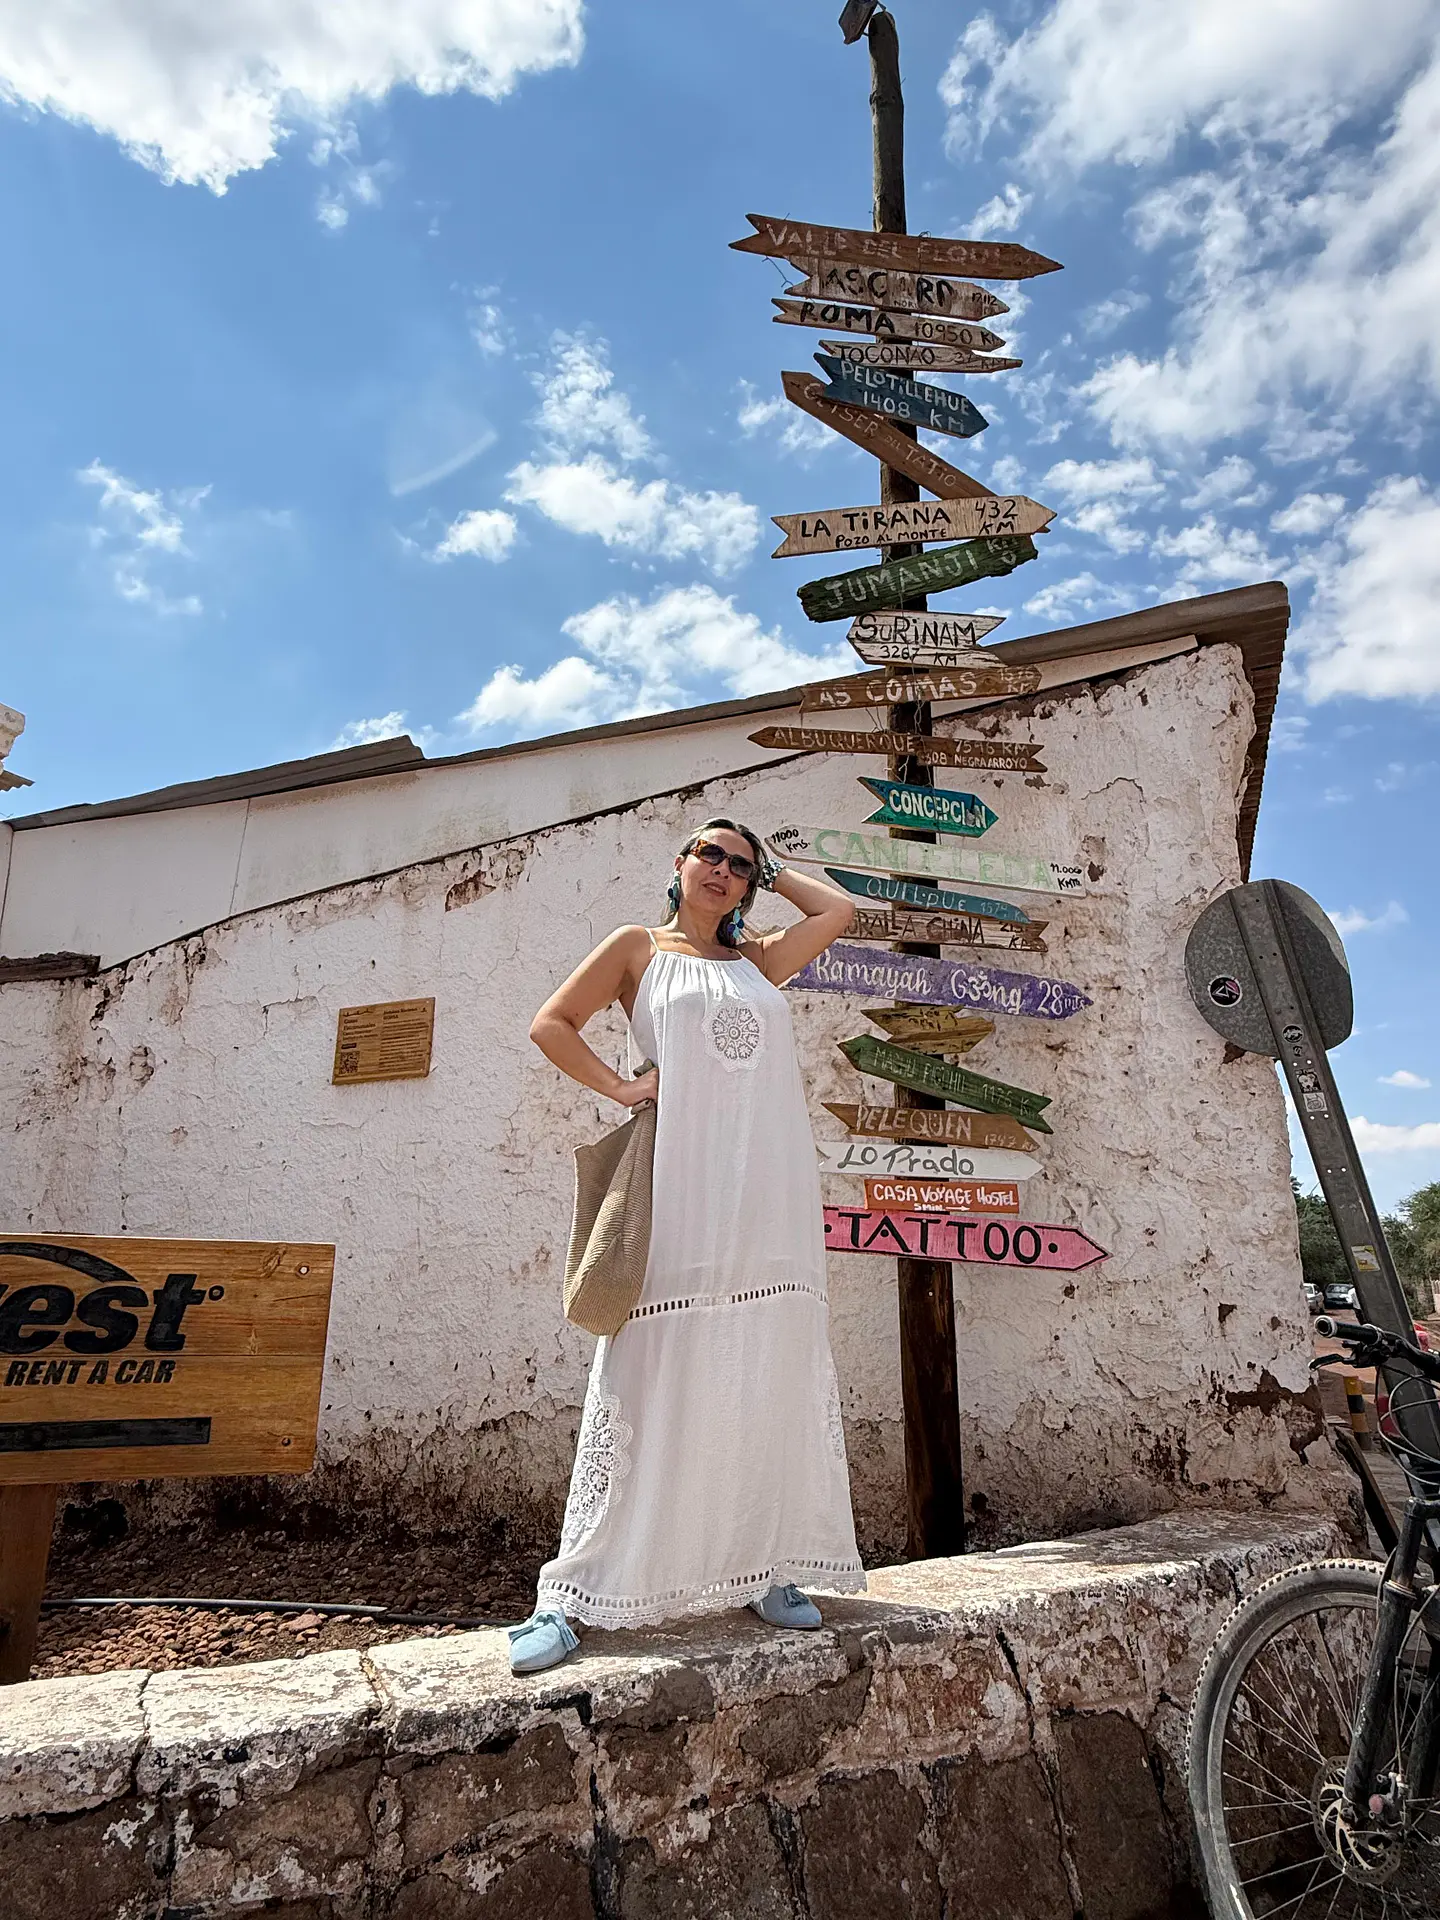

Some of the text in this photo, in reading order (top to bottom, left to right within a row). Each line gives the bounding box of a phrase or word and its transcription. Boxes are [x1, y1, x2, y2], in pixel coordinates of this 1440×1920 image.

[799, 300, 895, 334] ROMA
[914, 321, 972, 345] 10950
[836, 344, 936, 366] TOCONAO
[863, 390, 965, 434] 1408 KM
[975, 499, 1018, 520] 432
[801, 518, 832, 538] LA
[835, 528, 947, 548] POZO AL MONTE
[979, 521, 1014, 536] KM
[824, 549, 979, 610] JUMANJI
[880, 645, 957, 666] 3267 KM
[1038, 979, 1064, 1016] 28
[883, 1145, 975, 1176] Prado
[873, 1183, 1018, 1206] CASA VOYAGE HOSTEL
[837, 1211, 1042, 1265] TATTOO
[3, 1359, 177, 1387] RENT A CAR
